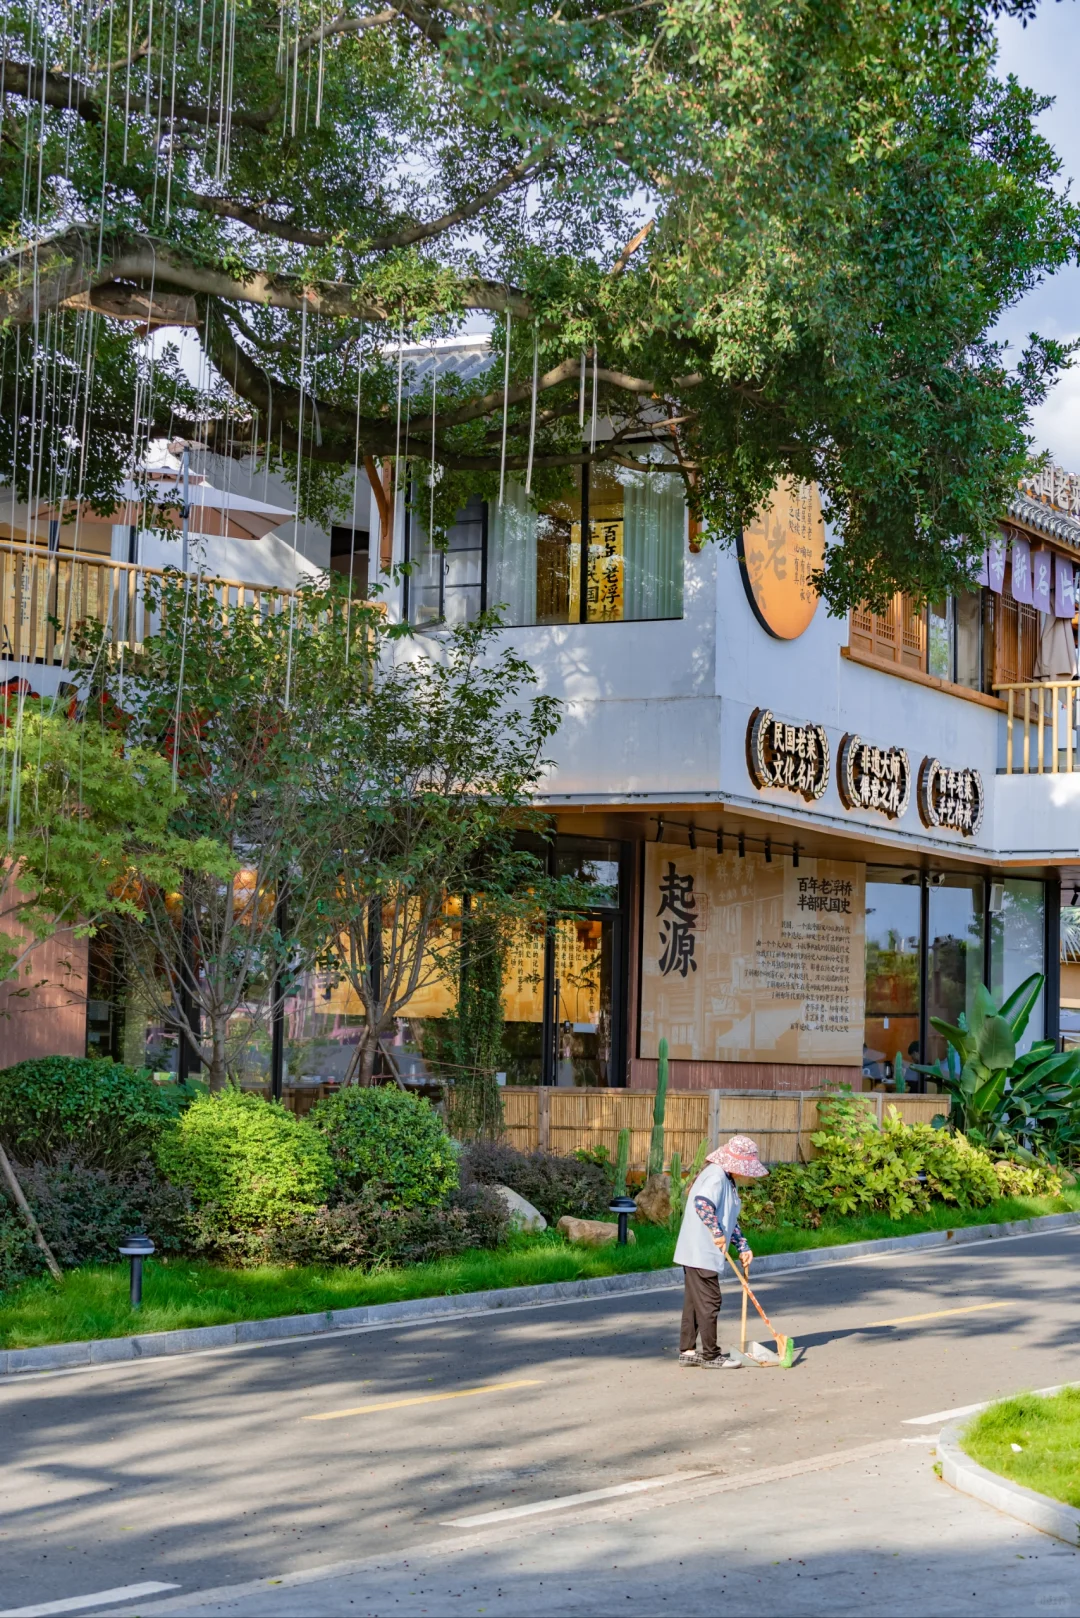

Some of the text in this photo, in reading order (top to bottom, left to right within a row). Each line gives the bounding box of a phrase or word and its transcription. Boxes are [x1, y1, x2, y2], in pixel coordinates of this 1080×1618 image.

[773, 722, 817, 760] 民国老菜
[772, 752, 817, 793] 文化名片
[860, 745, 900, 781] 非遗大师
[859, 774, 900, 813] 得意之作
[938, 769, 973, 801] 百年老菜
[938, 796, 974, 830] 手艺传承
[797, 876, 853, 896] 百年老浮桥
[656, 861, 698, 978] 起源
[796, 895, 852, 914] 半部民国史
